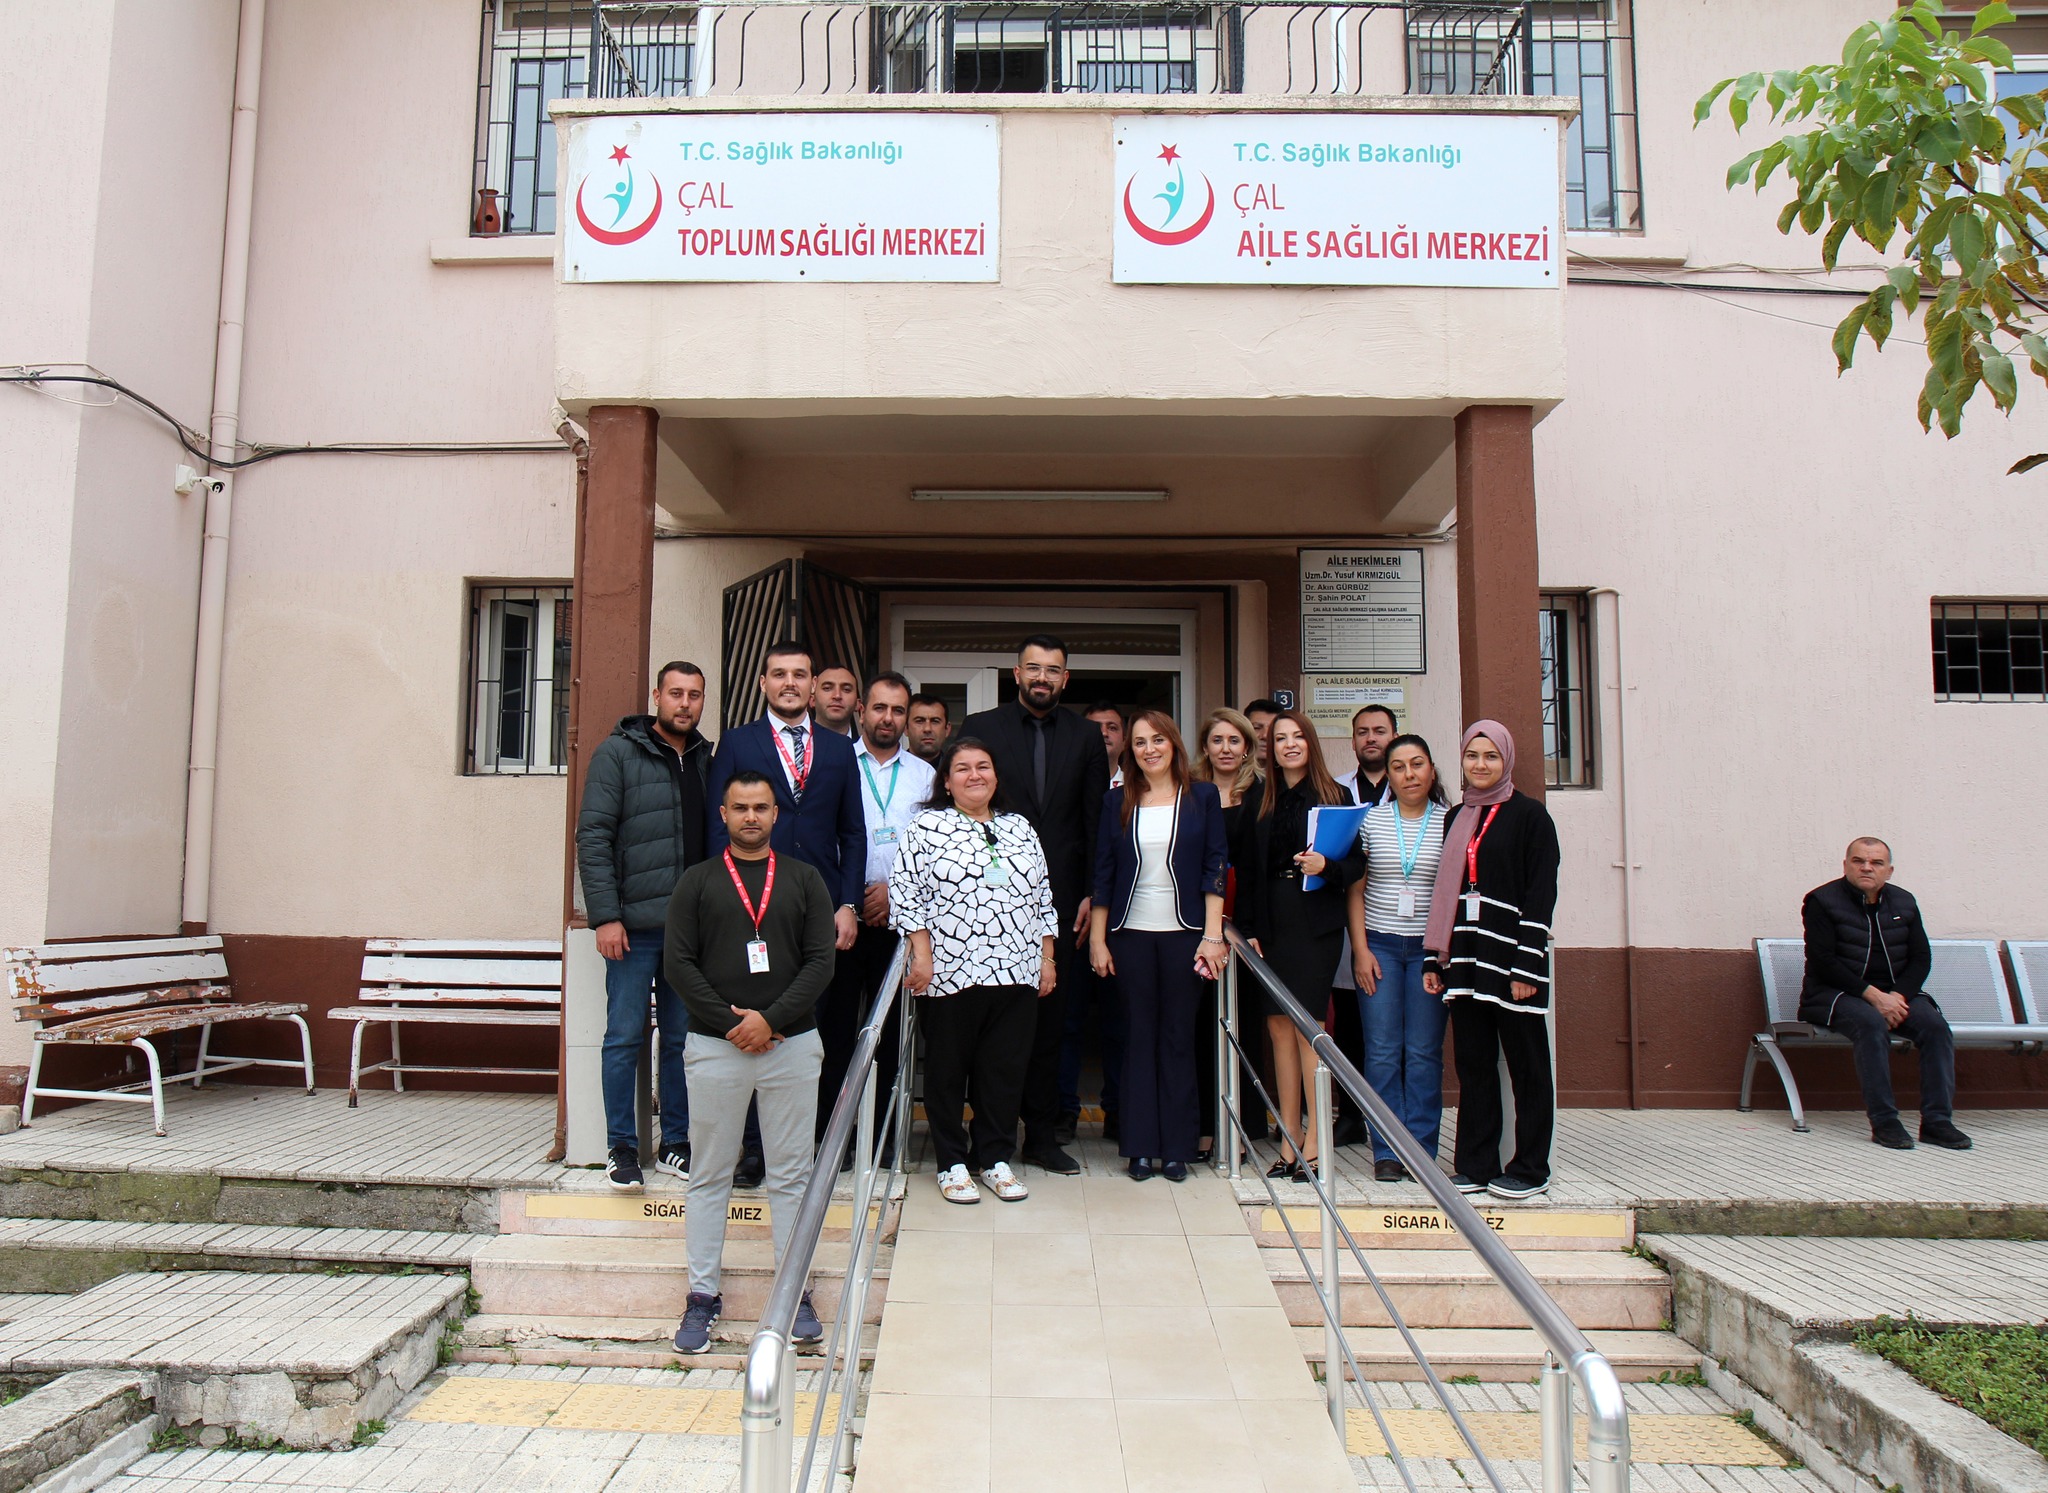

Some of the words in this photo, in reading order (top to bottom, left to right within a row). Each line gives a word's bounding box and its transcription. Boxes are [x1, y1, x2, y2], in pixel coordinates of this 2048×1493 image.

[679, 142, 720, 161] T.C.
[726, 141, 793, 165] Sağlık
[800, 140, 903, 165] Bakanlığı
[1233, 143, 1275, 162] T.C.
[1282, 142, 1350, 168] Sağlık
[1358, 143, 1462, 169] Bakanlığı
[677, 182, 734, 216] ÇAL
[1233, 183, 1285, 218] ÇAL
[678, 228, 775, 257] TOPLUM
[779, 222, 876, 257] SAĞLIĞI
[882, 222, 985, 257] MERKEZİ
[1237, 222, 1299, 258] AİLE
[1306, 224, 1418, 259] SAĞLIĞI
[1426, 226, 1549, 261] MERKEZİ
[1327, 555, 1348, 566] AİLE
[1350, 555, 1401, 566] HEKİMLERİ
[1334, 571, 1355, 579] Yusuf
[1336, 583, 1369, 591] GÜRBÜZ
[1317, 594, 1339, 602] Şahin
[1315, 677, 1329, 685] ÇAL
[1330, 676, 1344, 685] AİLE
[1345, 677, 1371, 685] SAĞLIĞI
[1372, 677, 1400, 685] MERKEZİ
[1280, 694, 1288, 705] 3
[1383, 1212, 1440, 1229] SİGARA
